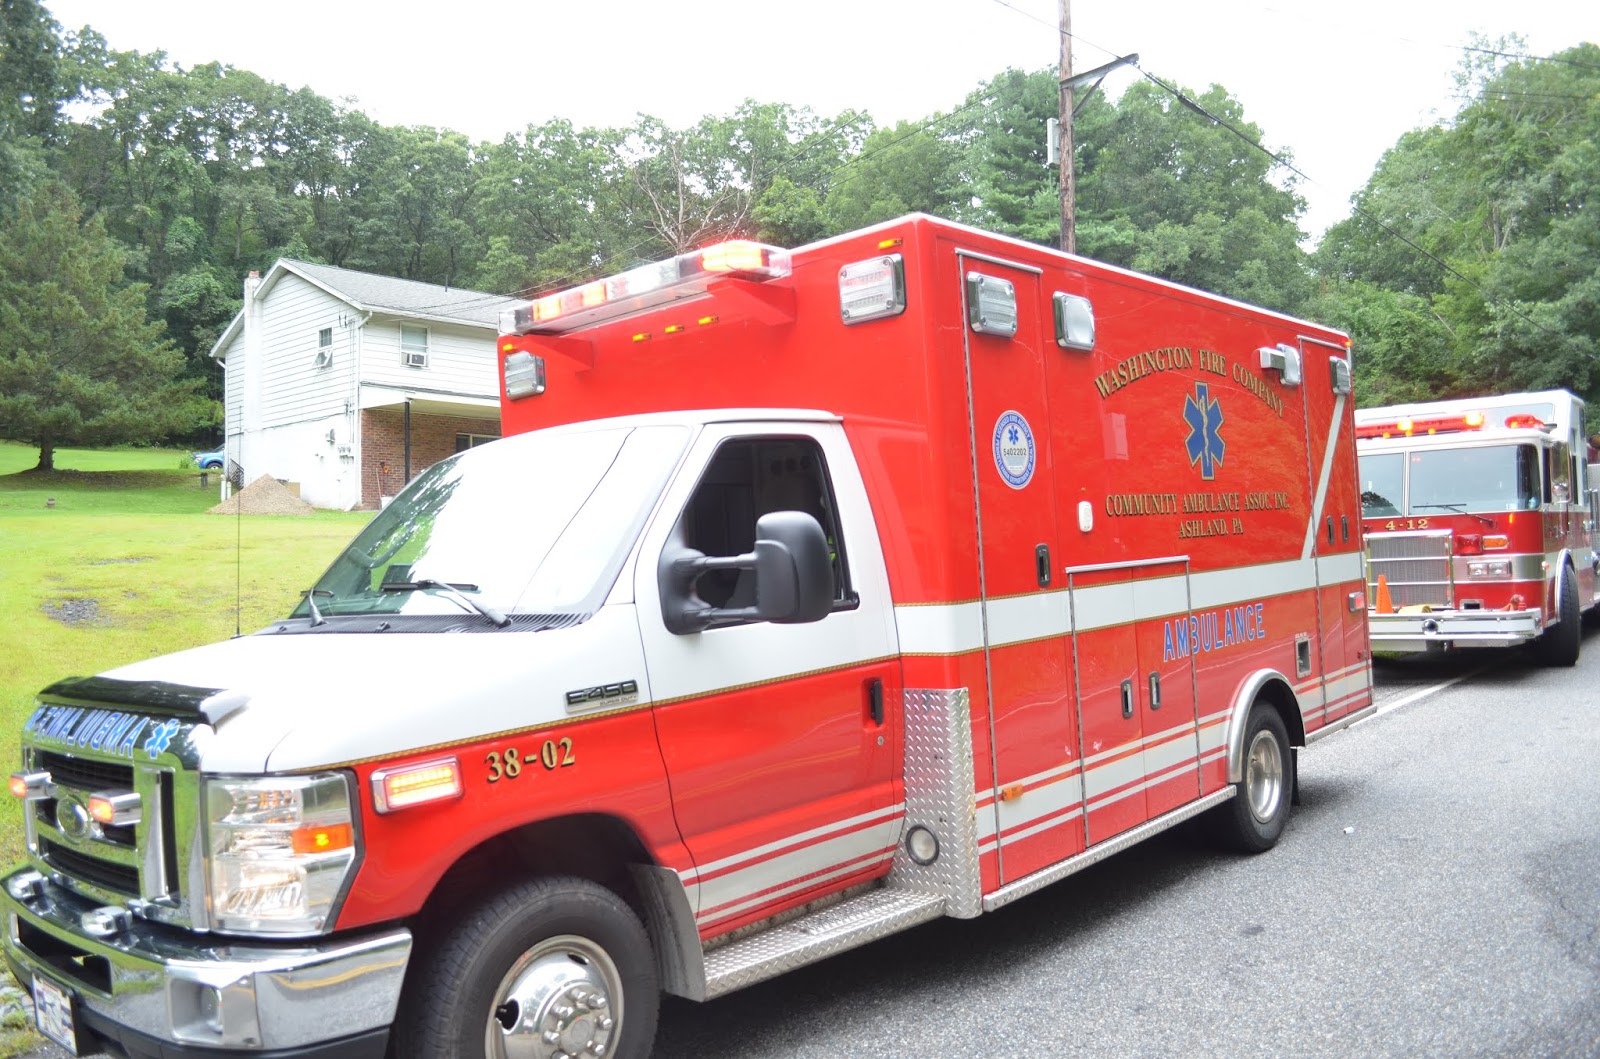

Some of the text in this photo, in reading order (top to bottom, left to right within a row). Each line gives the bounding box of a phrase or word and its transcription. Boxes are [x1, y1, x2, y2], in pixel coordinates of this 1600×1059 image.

[1094, 346, 1285, 419] WASHINGTON FIRE COMPANY
[1003, 447, 1027, 456] 5402202
[1105, 491, 1290, 517] COMMUNITY AMBULANCE ASSOC. INC.
[1232, 518, 1244, 535] PA
[1163, 603, 1265, 662] AMBULANCE
[485, 736, 576, 783] 38-02
